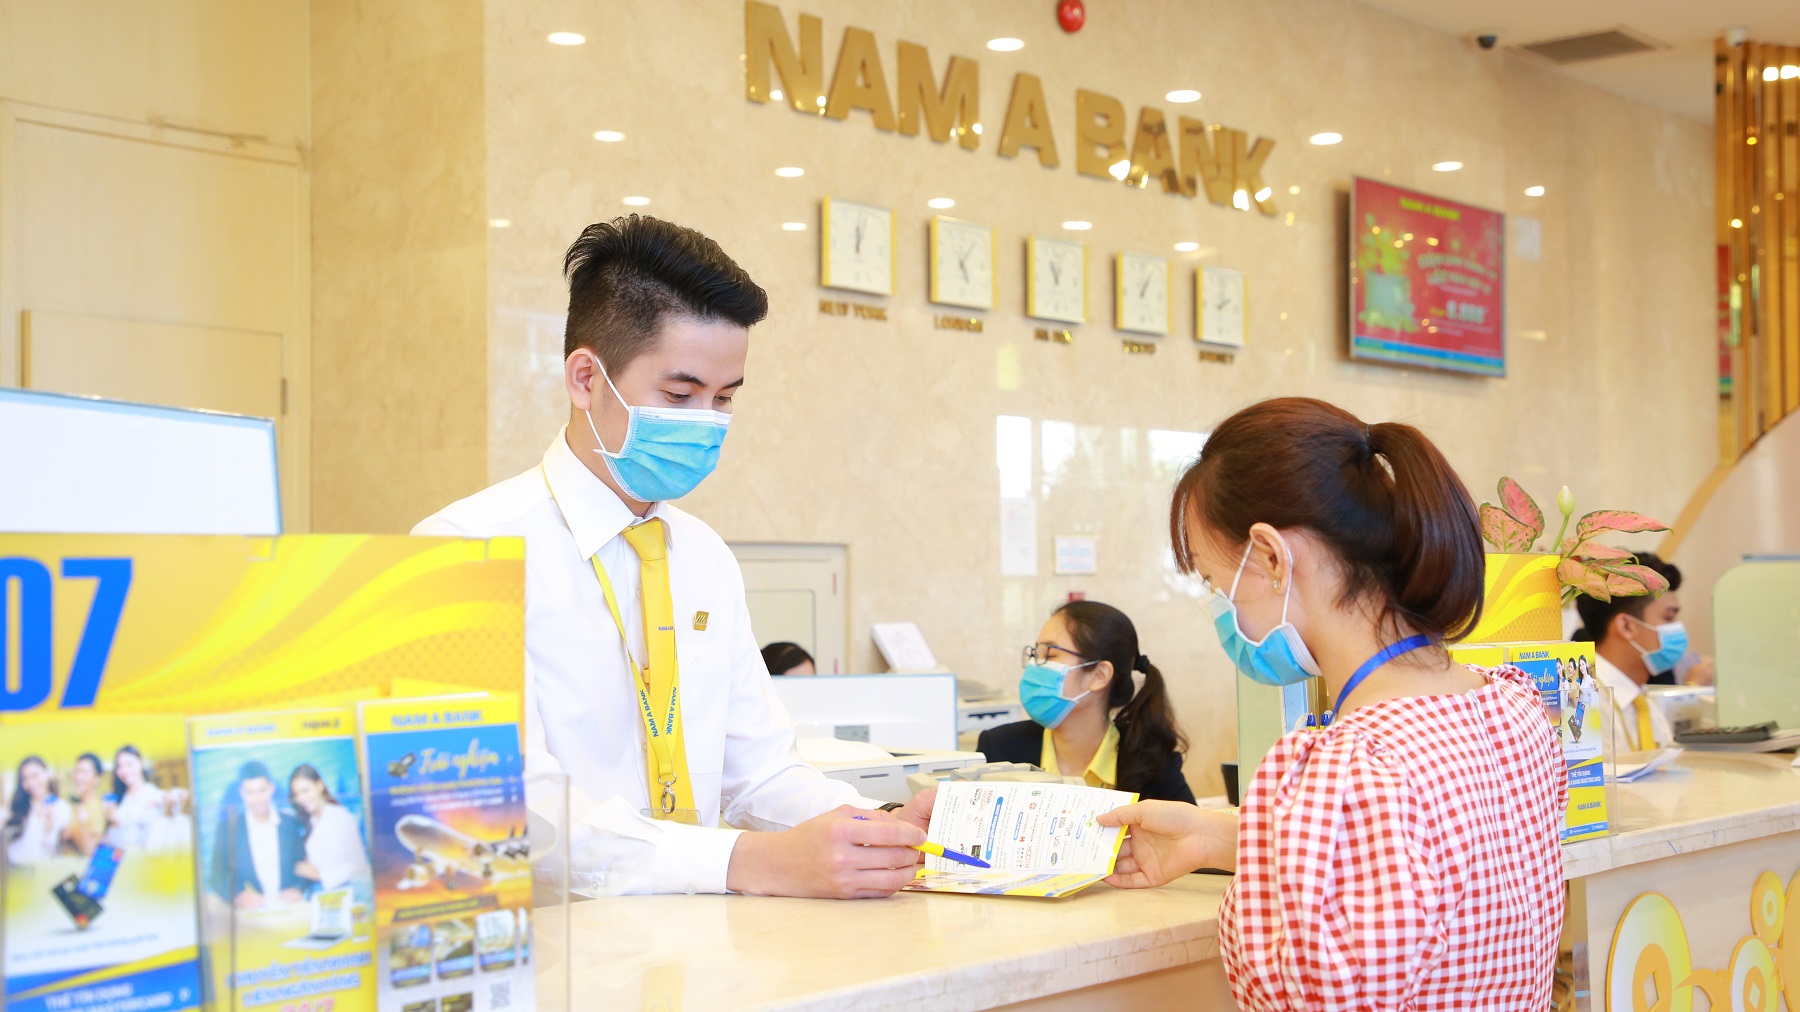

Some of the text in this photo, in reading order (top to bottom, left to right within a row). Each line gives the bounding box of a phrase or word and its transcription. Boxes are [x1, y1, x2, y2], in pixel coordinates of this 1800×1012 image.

[745, 0, 1278, 217] NAM A BANK
[0, 557, 134, 713] 07
[1519, 652, 1531, 660] NAM
[1536, 651, 1549, 659] BANK
[640, 689, 651, 711] BANK
[648, 718, 659, 737] NAM
[665, 713, 674, 735] BANK
[1023, 844, 1032, 869] KLOOK
